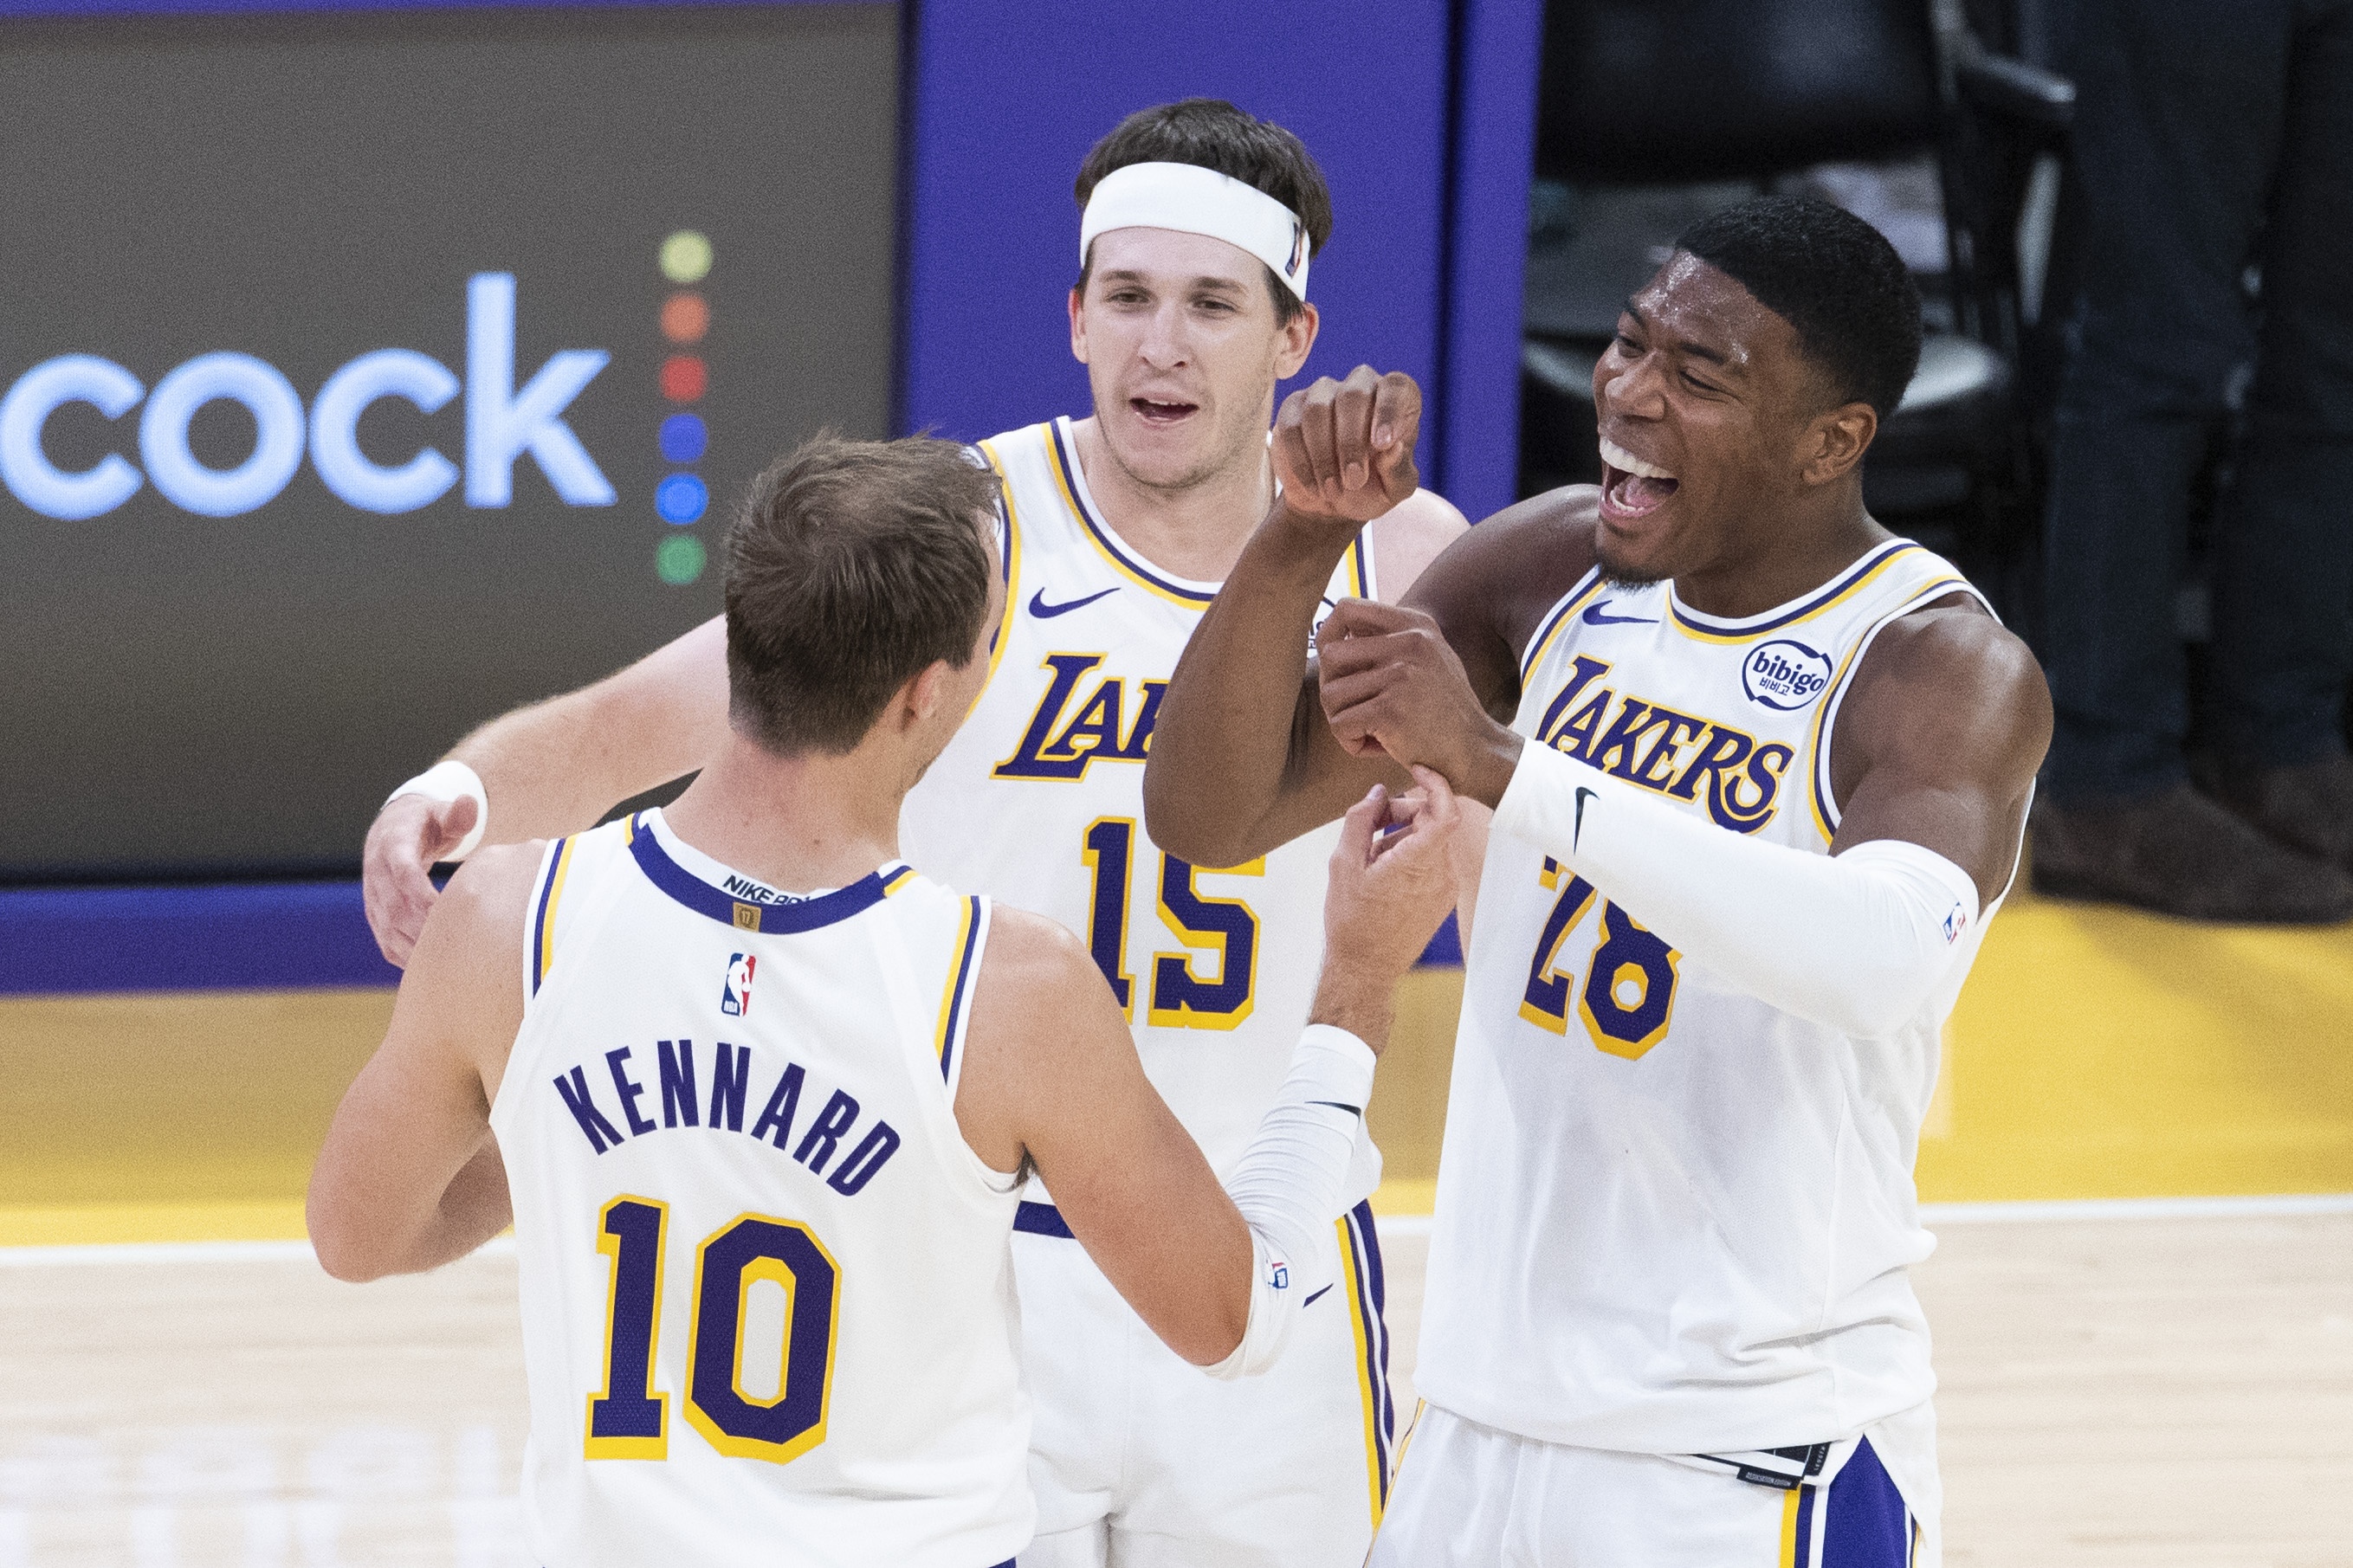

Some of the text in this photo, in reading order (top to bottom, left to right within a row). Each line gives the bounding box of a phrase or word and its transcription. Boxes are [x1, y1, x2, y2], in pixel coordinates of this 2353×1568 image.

[0, 271, 618, 521] cock
[1535, 652, 1795, 836] LAKERS
[1753, 651, 1825, 695] bibigo
[1759, 677, 1791, 696] 비비고
[722, 874, 774, 903] NIKE
[1081, 815, 1266, 1031] 15
[1517, 854, 1684, 1061] 28
[553, 1039, 901, 1197] KENNARD
[584, 1192, 843, 1465] 10
